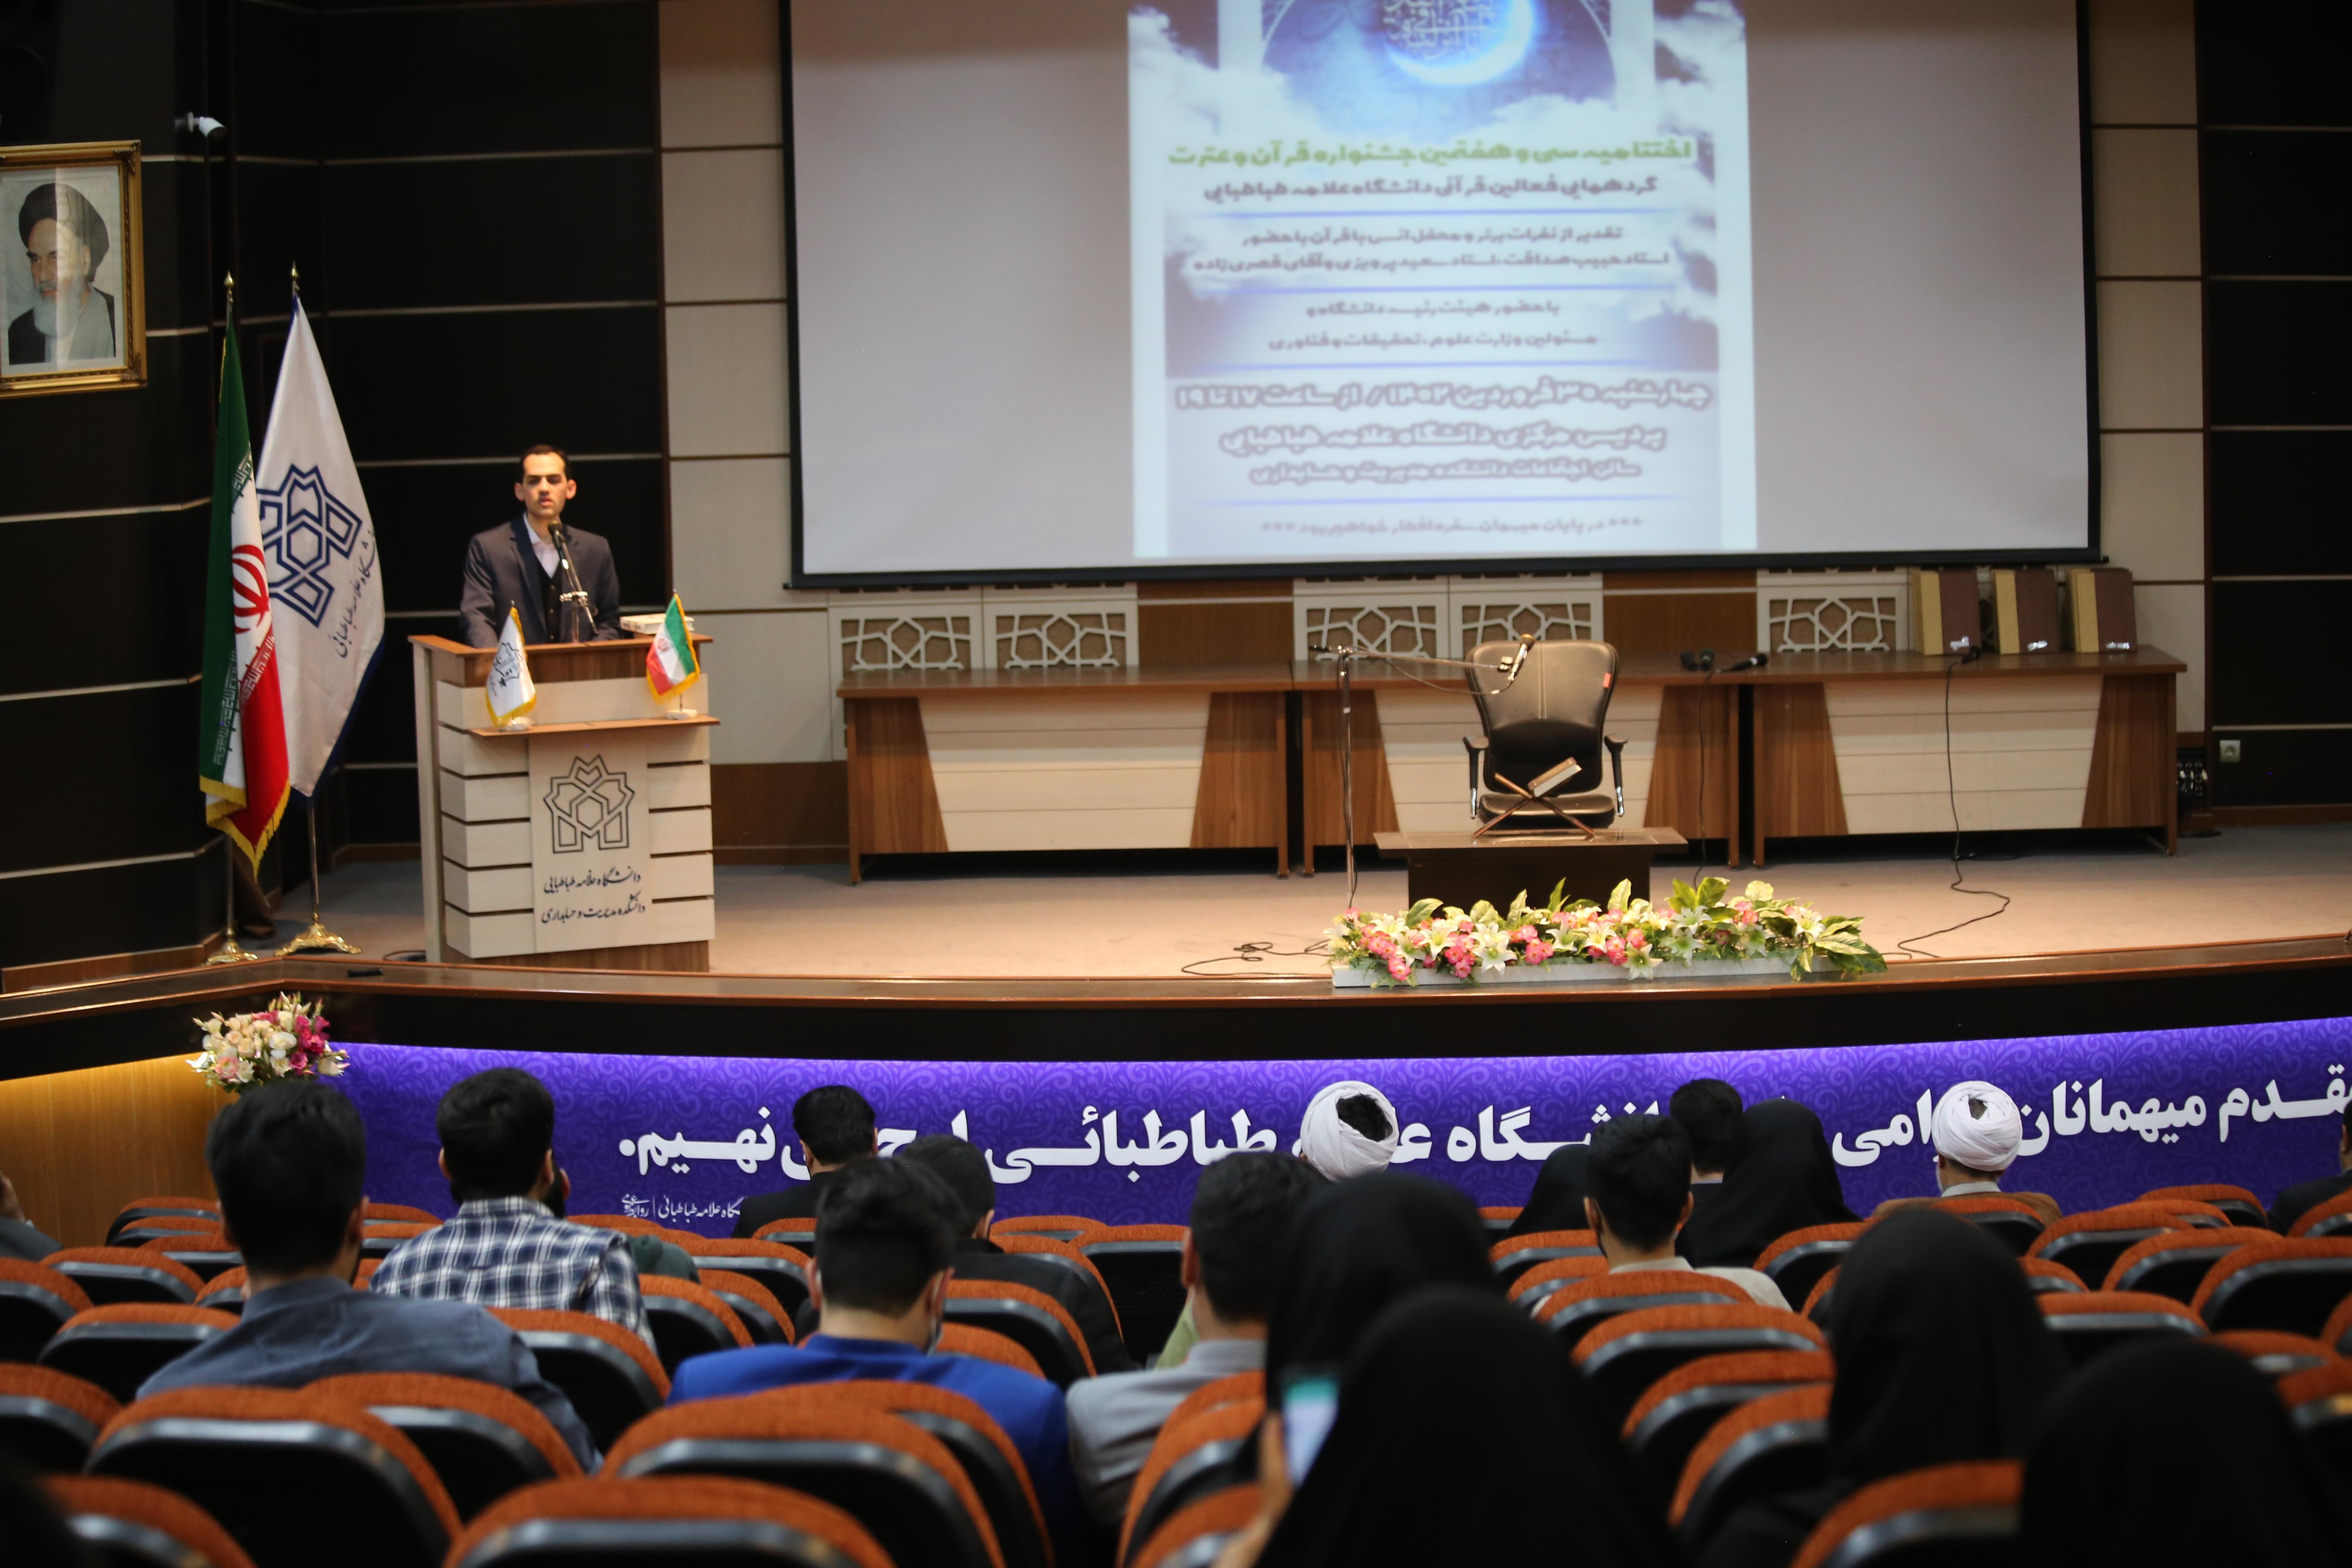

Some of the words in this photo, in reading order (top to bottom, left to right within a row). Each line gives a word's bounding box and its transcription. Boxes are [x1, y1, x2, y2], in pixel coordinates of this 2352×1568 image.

[1168, 147, 1231, 167] عترت
[1232, 150, 1247, 166] و
[1250, 140, 1311, 166] قرآن
[1314, 143, 1417, 167] جشنواره
[1419, 139, 1512, 166] هفتمین
[1515, 149, 1529, 164] و
[1291, 181, 1351, 196] علامه
[1351, 176, 1433, 194] دانشگاه
[1488, 173, 1559, 198] فعالین
[1559, 227, 1574, 243] از
[2017, 1078, 2207, 1157] میهمانان
